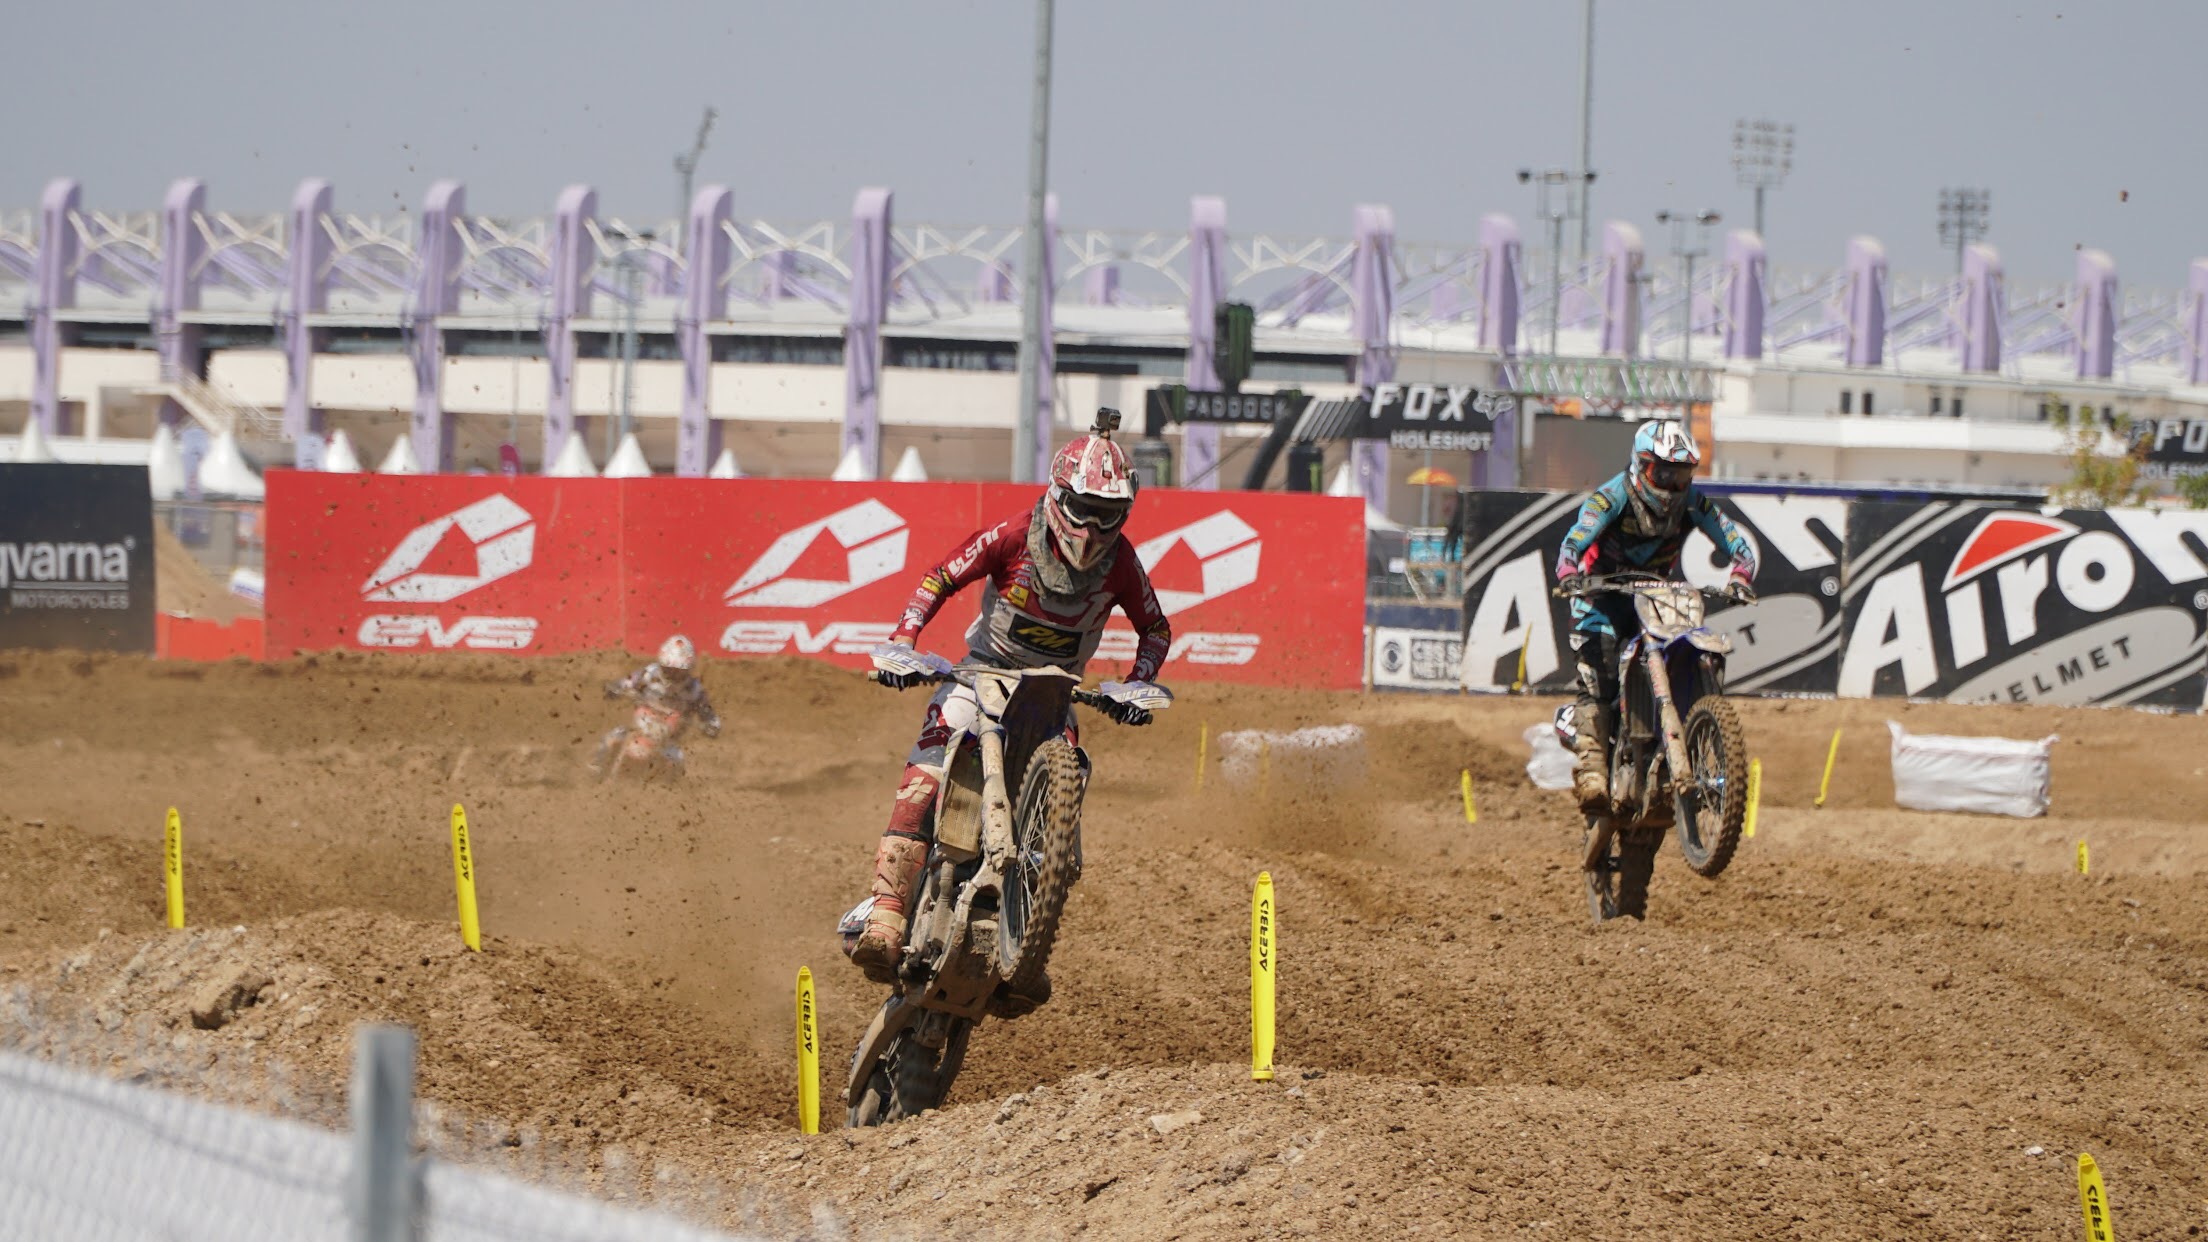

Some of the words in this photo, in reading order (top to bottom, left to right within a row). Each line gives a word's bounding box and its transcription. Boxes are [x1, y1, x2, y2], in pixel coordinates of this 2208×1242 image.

[1186, 395, 1292, 420] PADDOCK
[1370, 383, 1471, 421] FOX
[1391, 430, 1492, 451] HOLESHOT
[11, 591, 130, 609] MOTORCYCLES
[457, 824, 471, 881] ACERBIS
[1258, 899, 1270, 972] ACERBIS
[802, 989, 813, 1054] ACERBIS
